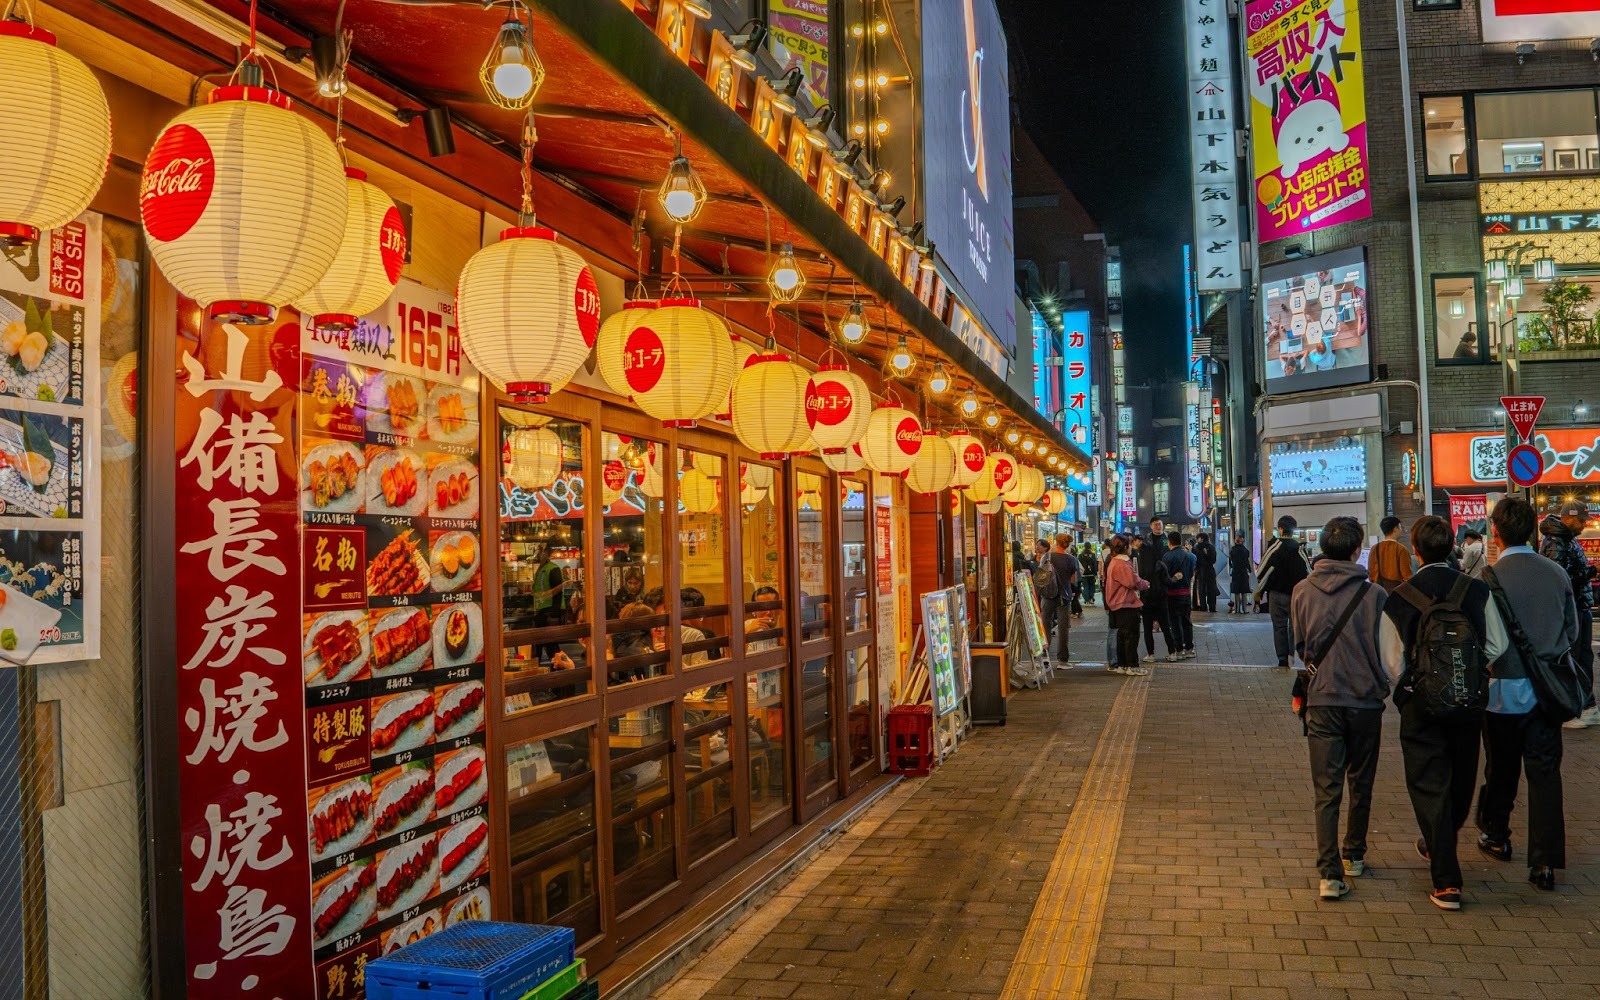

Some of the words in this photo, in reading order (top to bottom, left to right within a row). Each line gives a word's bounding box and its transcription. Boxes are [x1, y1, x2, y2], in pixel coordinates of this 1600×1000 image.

[1197, 0, 1218, 72] ぬき麺
[1253, 8, 1347, 87] 高収入
[1271, 44, 1356, 118] バイト
[1197, 107, 1233, 279] 山下本気うどん
[1271, 167, 1365, 228] プレゼント中
[1283, 146, 1362, 201] 入店応援金
[962, 187, 991, 263] JUICE
[1509, 400, 1538, 412] 止まれ
[1514, 413, 1534, 423] STOP
[312, 536, 358, 572] 名物
[40, 626, 61, 643] 270
[313, 705, 366, 744] 特製豚
